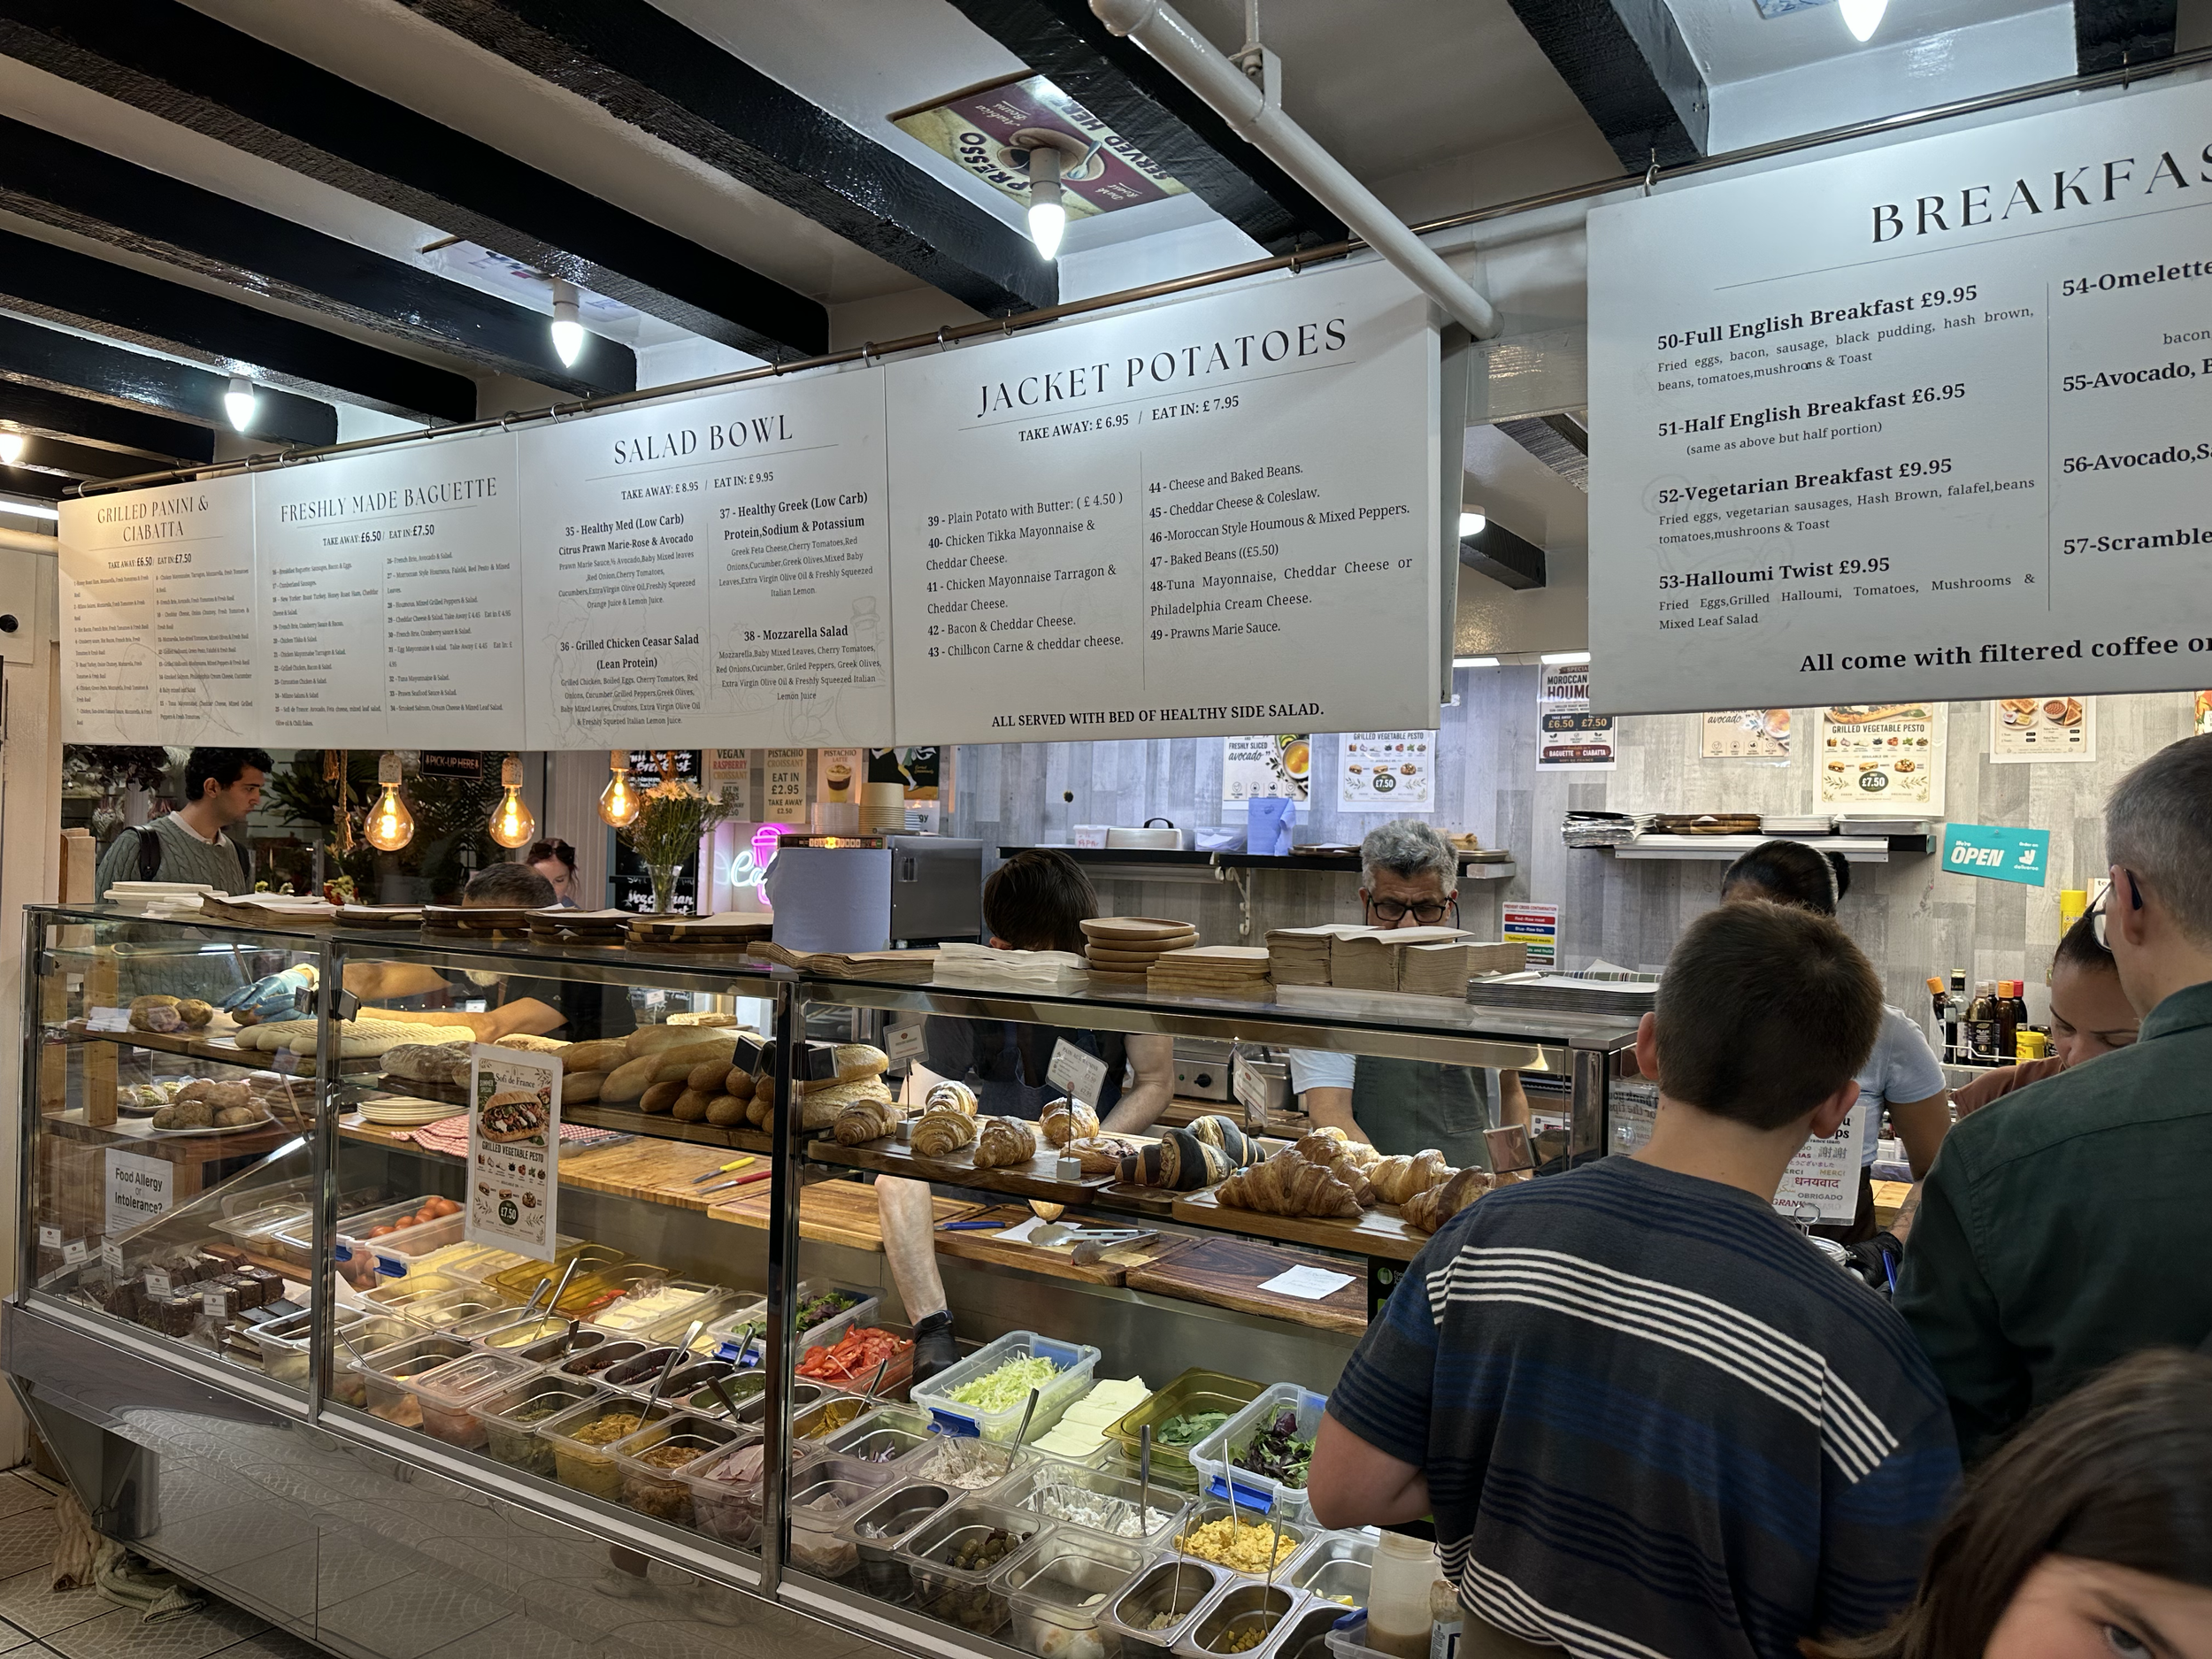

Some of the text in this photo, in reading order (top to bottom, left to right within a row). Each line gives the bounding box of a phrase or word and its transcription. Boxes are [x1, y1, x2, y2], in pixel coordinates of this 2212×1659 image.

[975, 104, 1021, 127] Arabica
[993, 102, 1029, 121] Beans
[1055, 99, 1106, 130] HER
[960, 132, 1031, 191] PRESSO
[1105, 135, 1169, 180] SERVED
[1095, 187, 1125, 201] Dark
[1658, 285, 1977, 350] 50-Full English Breakfast £9.95
[978, 319, 1345, 419] JACKET POTATOES
[1658, 383, 1965, 437] 51-Half English Breakfast £6.95
[615, 415, 792, 465] SALAD BOWL
[281, 477, 496, 522] FRESHLY MADE BAGUETTE
[97, 495, 208, 524] GRILLED PANINI &
[123, 521, 183, 541] CIABATTA
[361, 531, 381, 542] £6.50
[389, 530, 402, 539] EAT
[413, 524, 434, 536] £7.50
[928, 519, 1095, 549] 40- Chicken Tikka Mayonnaise &
[558, 533, 694, 556] Citrus Prawn Marie-Rose & Avocado
[137, 557, 152, 566] £6.50
[175, 553, 191, 564] £7.50
[1150, 558, 1412, 592] 48-Tuna Mayonnaise, Cheddar Cheese or
[771, 588, 792, 597] Italian
[1151, 595, 1311, 616] Philadelphia Cream Cheese.
[1659, 613, 1758, 630] Mixed Leaf Salad
[1799, 653, 1834, 672] All
[1842, 654, 1906, 670] come
[1914, 646, 1972, 666] with
[1979, 640, 2083, 663] filtered
[2092, 635, 2178, 657] coffee
[596, 657, 657, 671] (Lean Protein)
[1548, 675, 1587, 685] MOROCCAN
[801, 692, 817, 702] Juice
[992, 703, 1324, 727] ALL SERVED WITH BED OF HEALTHY SIDE SALAD.
[1548, 718, 1607, 728] £6.50 £7.50
[1708, 715, 1742, 724] avocado
[1832, 724, 1924, 733] GRILLED VEGETABLE PESTO
[718, 749, 745, 759] VEGAN
[768, 749, 803, 758] PISTACHIO
[1228, 750, 1263, 762] avocado
[457, 757, 475, 769] HERE
[712, 760, 748, 770] RASPBERRY
[767, 759, 803, 768] CROISSANT
[712, 771, 748, 780] CROISSANT
[772, 773, 800, 782] EAT IN
[1375, 779, 1394, 788] £7.50
[1862, 777, 1886, 787] £7.50
[772, 785, 799, 795] £2.95
[1950, 846, 2004, 867] OPEN
[731, 850, 776, 887] Ca
[495, 1073, 535, 1088] Sofi de France
[481, 1141, 544, 1164] GRILLED VEGETABLE PESTO
[116, 1168, 163, 1191] Food Allergy
[115, 1192, 162, 1214] Intolerance?
[1798, 1192, 1843, 1201] OBRIGADO
[500, 1207, 517, 1220] £7.50
